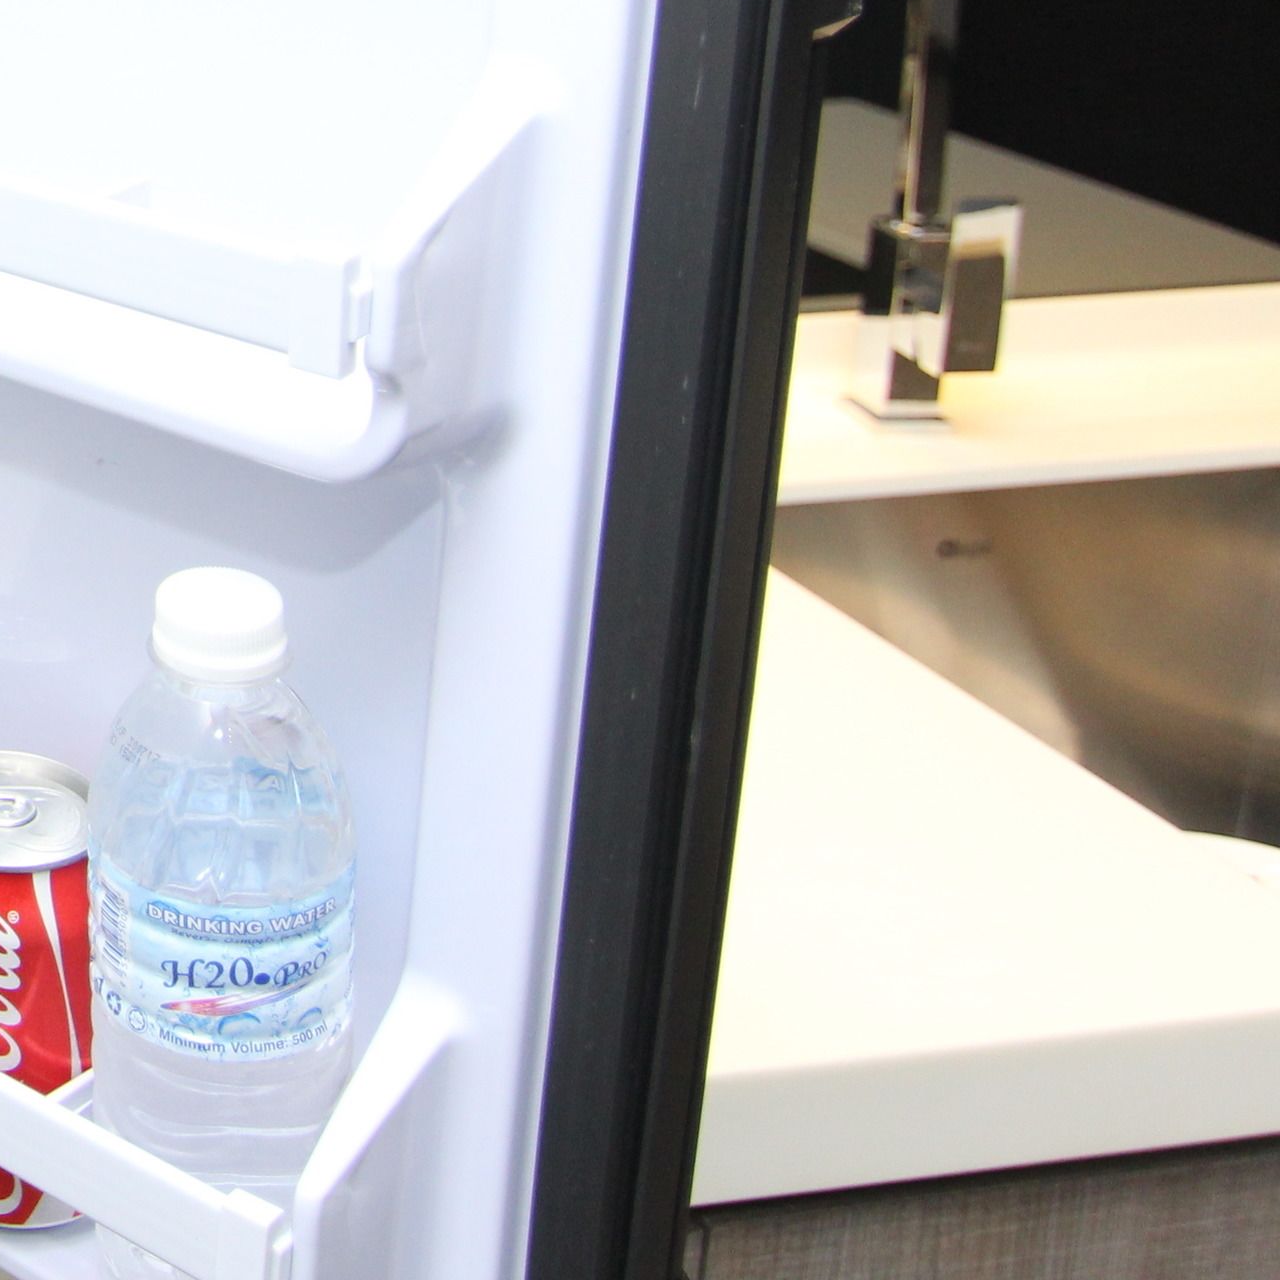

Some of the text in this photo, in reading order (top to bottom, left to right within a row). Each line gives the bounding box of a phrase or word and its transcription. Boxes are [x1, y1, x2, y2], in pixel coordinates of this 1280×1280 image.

[147, 903, 263, 934] DRINKING
[270, 898, 336, 932] WATER
[159, 1020, 328, 1054] Minimum Volume: 500 ml
